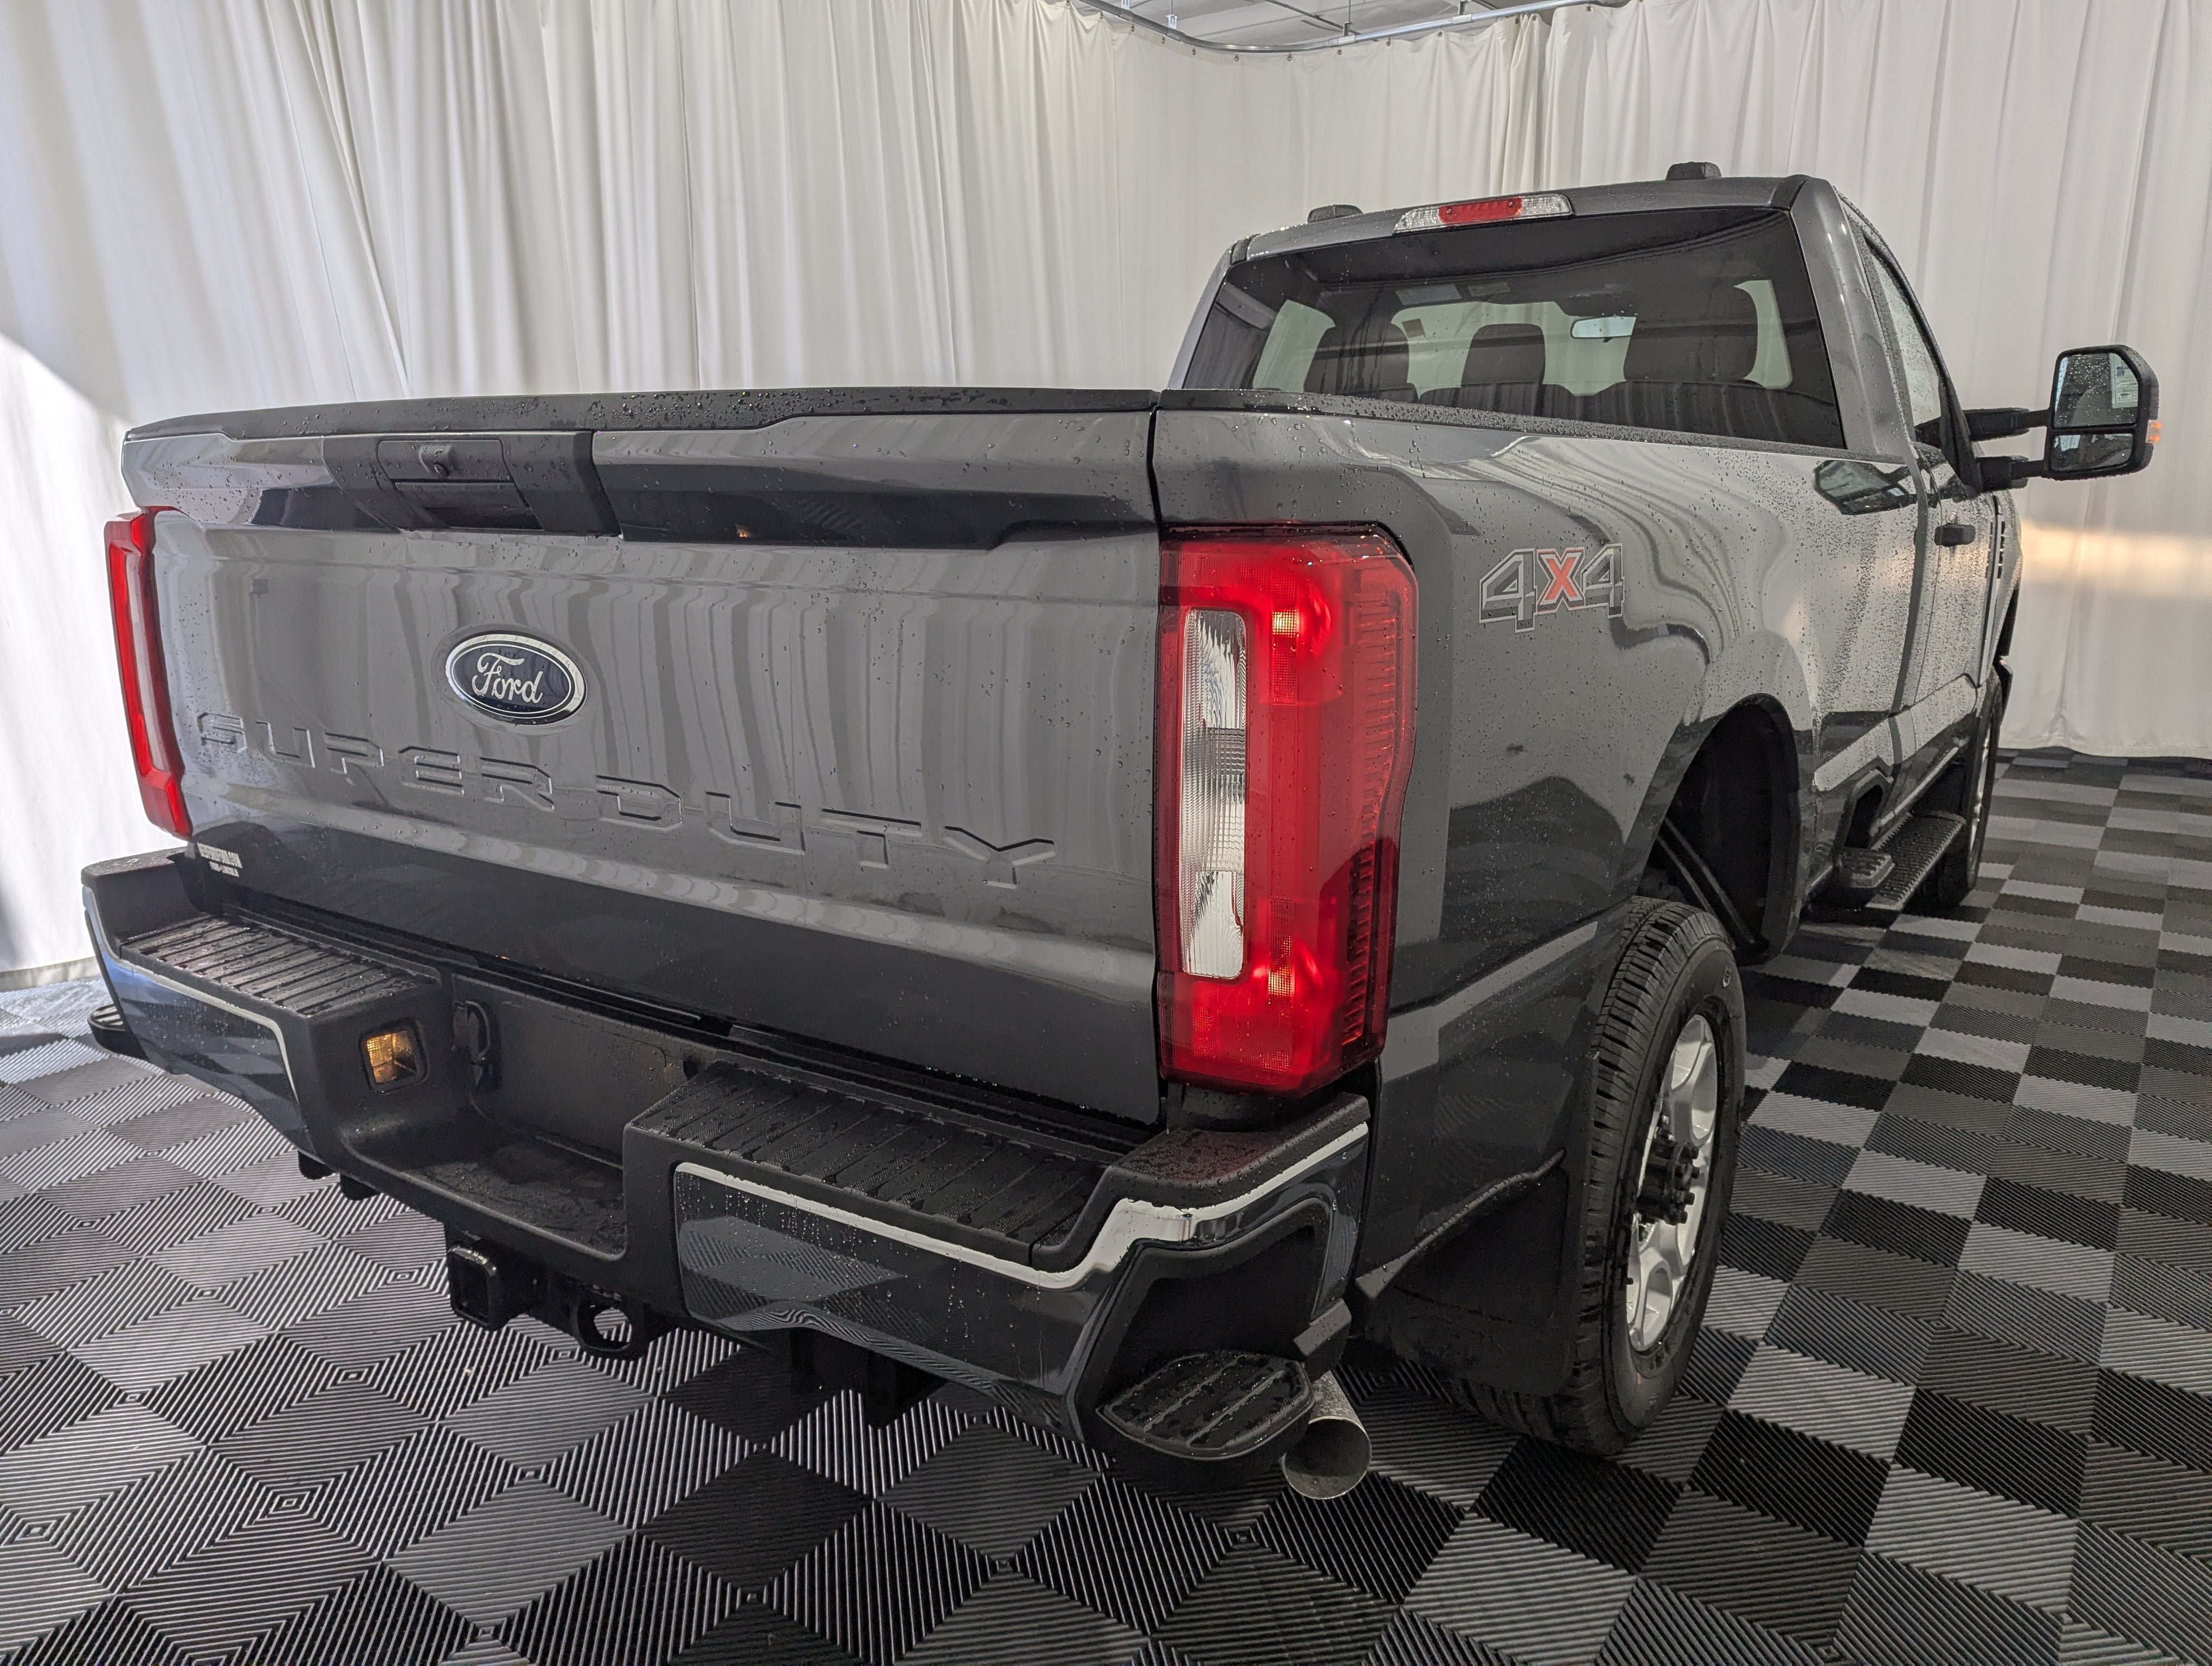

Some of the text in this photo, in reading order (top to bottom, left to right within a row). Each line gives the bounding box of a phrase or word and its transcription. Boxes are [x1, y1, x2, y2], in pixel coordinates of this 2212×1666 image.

[1479, 543, 1624, 633] 4X4
[472, 652, 543, 703] Ford
[197, 712, 1056, 889] SUPER DUTY
